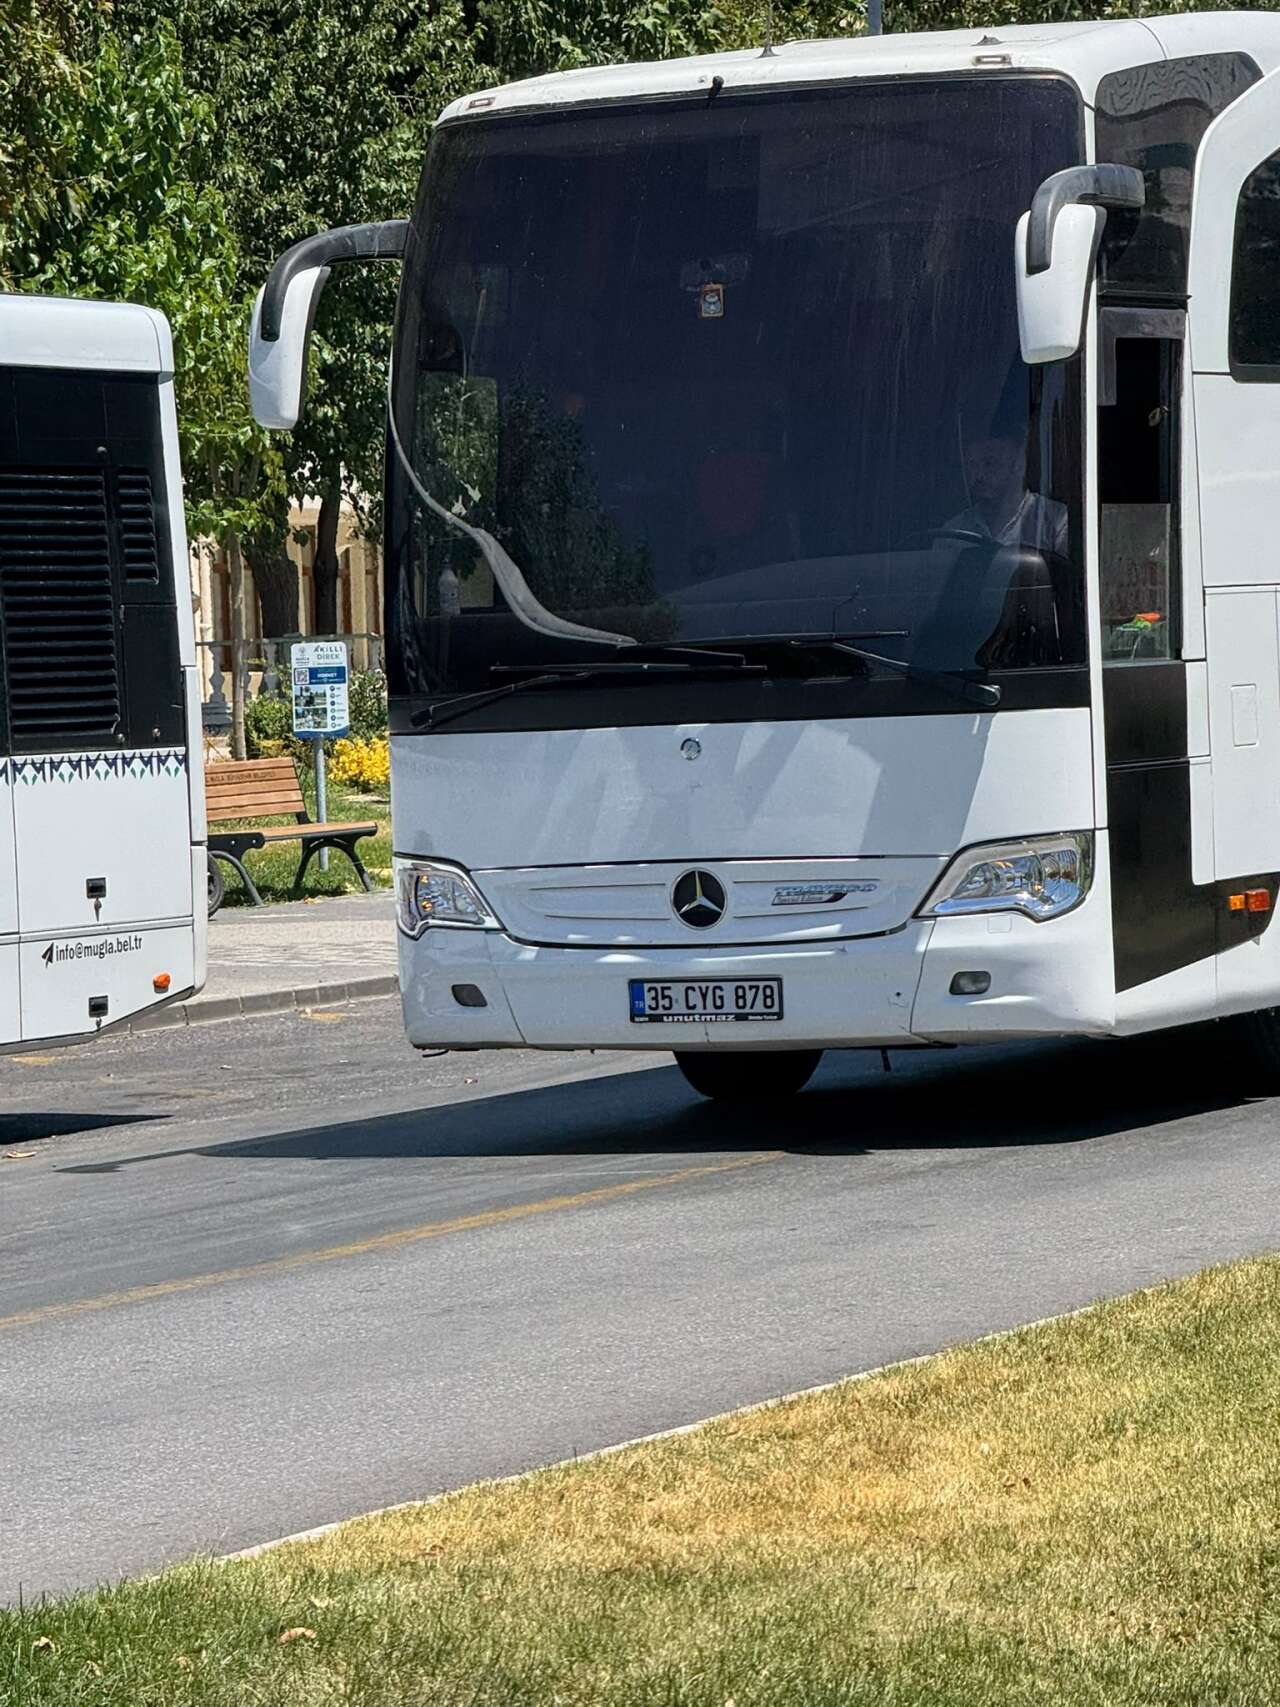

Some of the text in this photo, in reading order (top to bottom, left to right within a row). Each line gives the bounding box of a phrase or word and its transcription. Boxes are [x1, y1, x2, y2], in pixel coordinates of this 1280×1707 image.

[55, 935, 142, 962] info@mugla.bel.tr
[635, 1000, 645, 1008] TR
[647, 984, 776, 1011] 35 CYG 878
[662, 1014, 736, 1023] unutmaz
